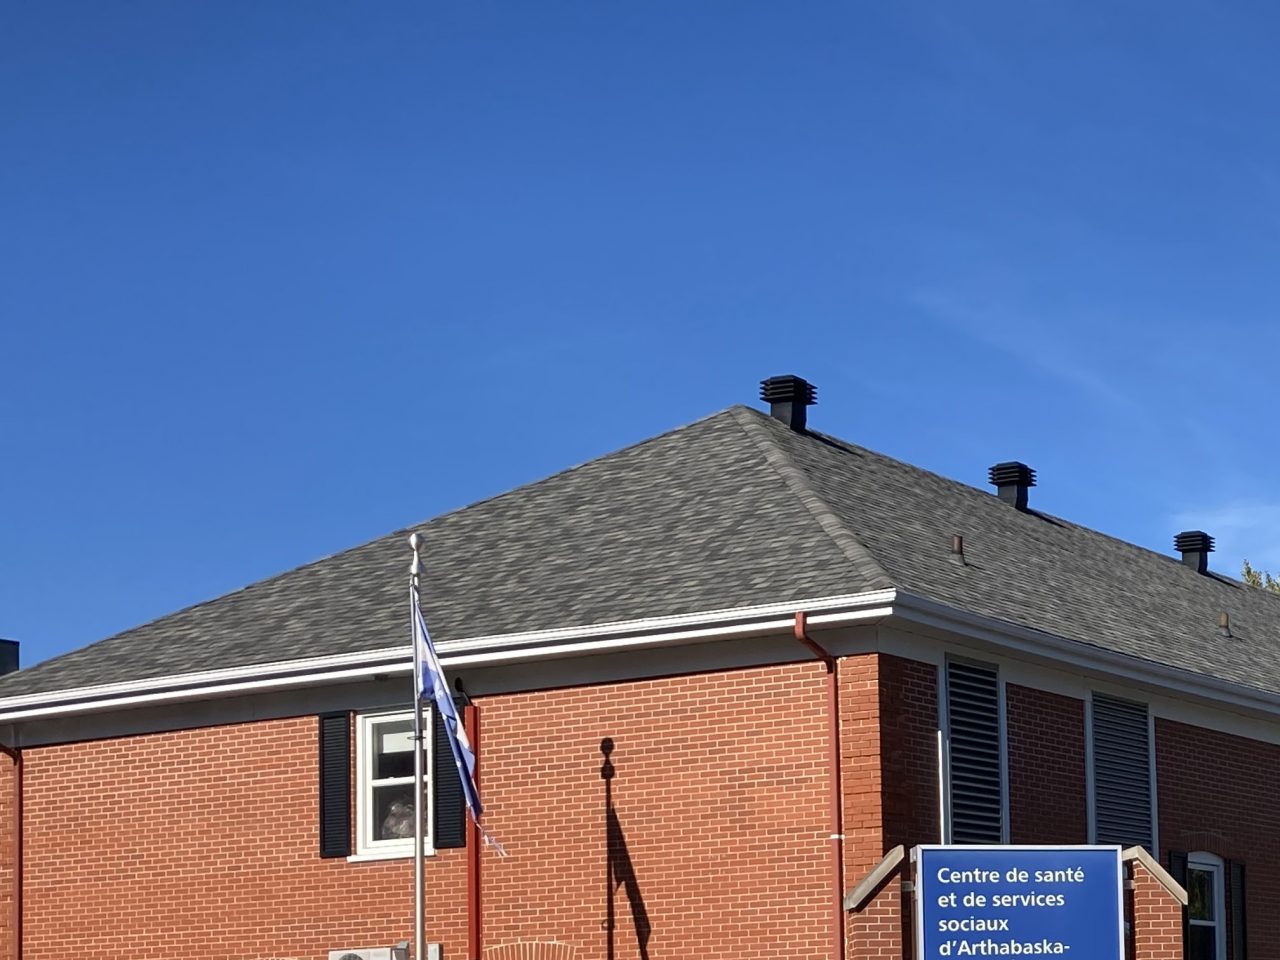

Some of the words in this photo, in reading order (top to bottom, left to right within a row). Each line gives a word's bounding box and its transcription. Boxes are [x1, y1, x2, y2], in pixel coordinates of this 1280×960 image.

[937, 867, 1000, 883] Centre
[1005, 867, 1030, 883] de
[1034, 866, 1085, 883] santé
[937, 892, 957, 907] et
[962, 891, 987, 907] de
[992, 891, 1065, 907] services
[938, 916, 1009, 932] sociaux
